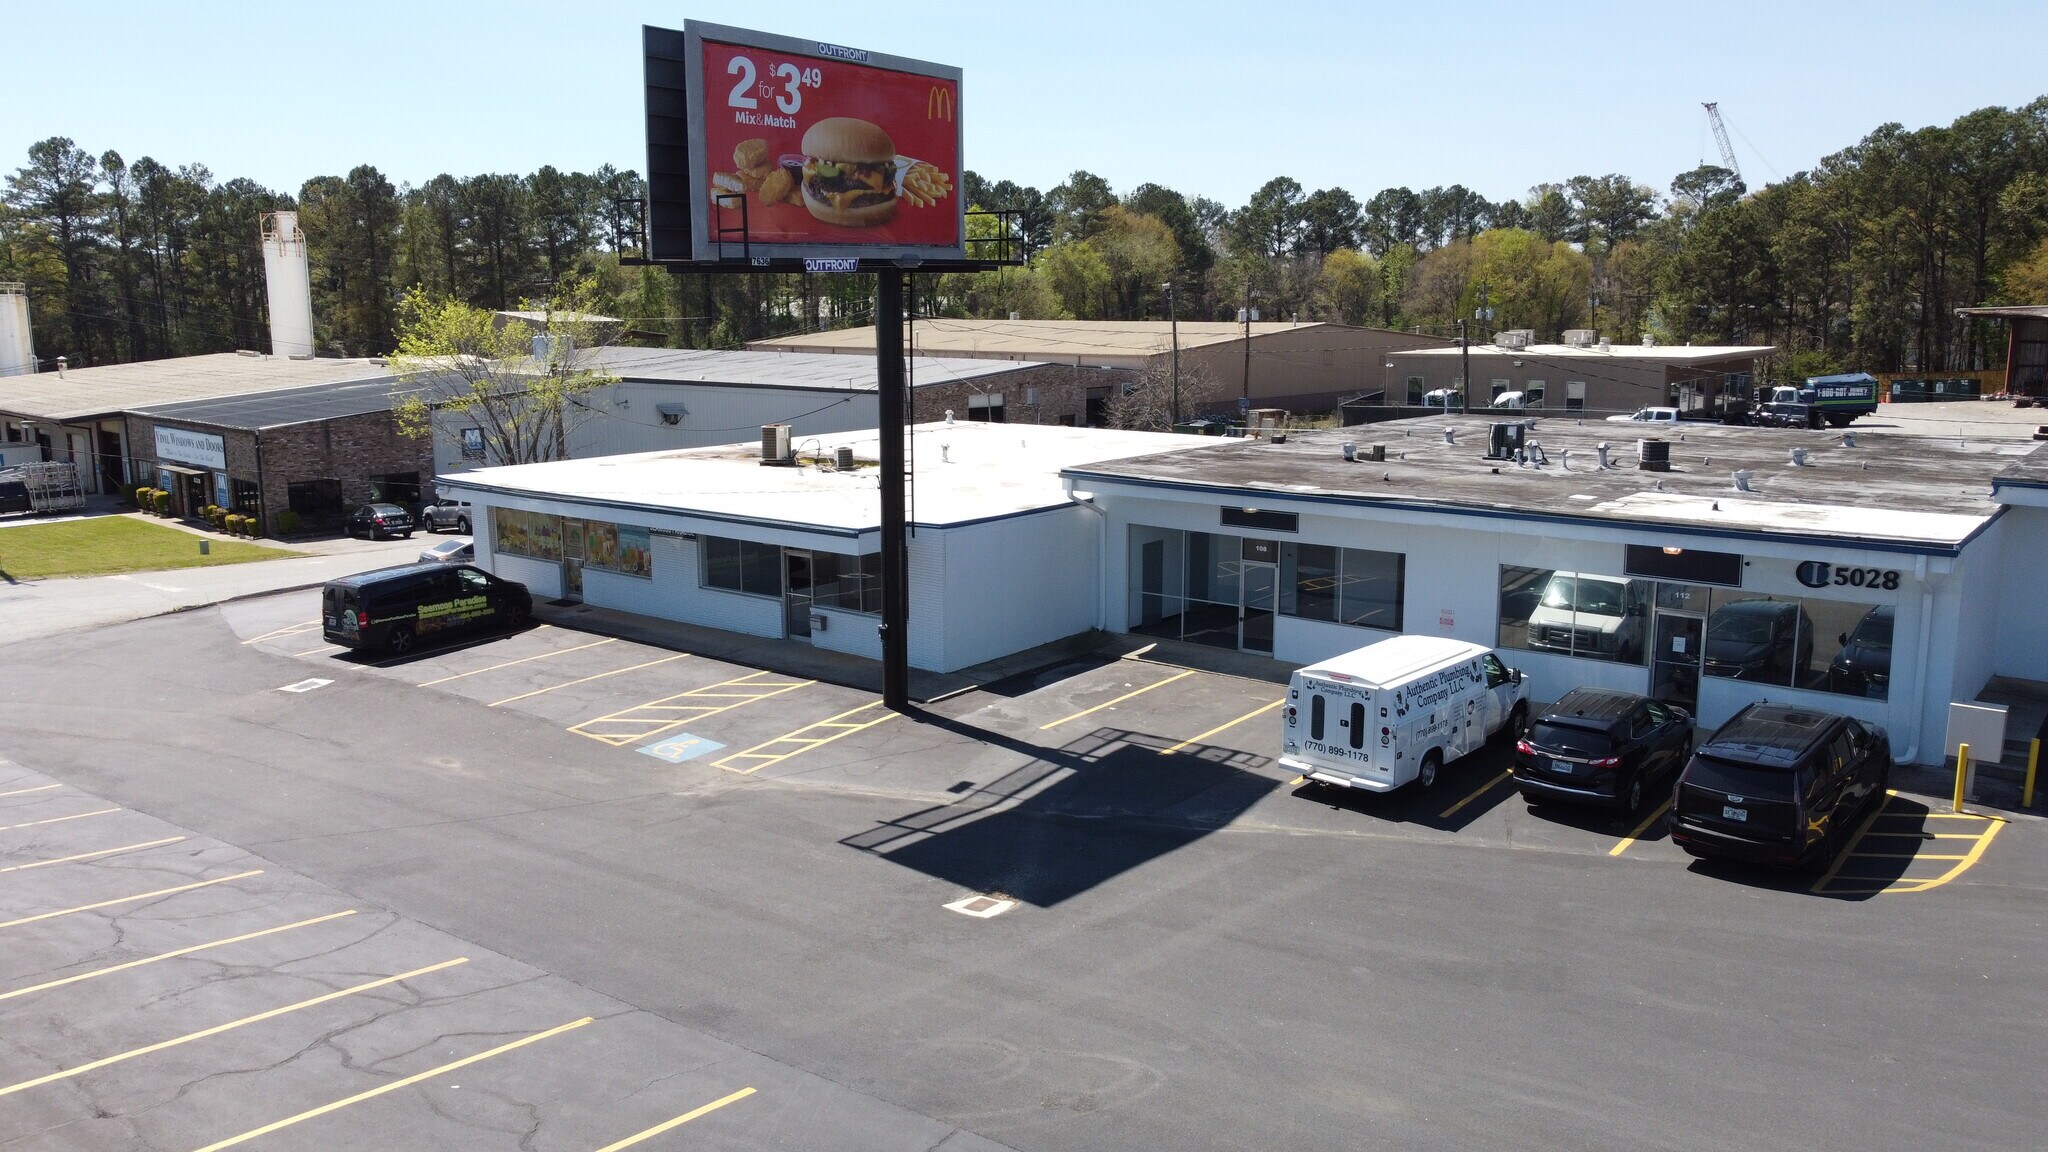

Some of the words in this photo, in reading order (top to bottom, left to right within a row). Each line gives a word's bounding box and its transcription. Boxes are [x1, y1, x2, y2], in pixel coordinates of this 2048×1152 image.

[818, 43, 868, 62] OUTFRONT
[727, 56, 758, 110] 2
[758, 80, 775, 99] for
[805, 259, 856, 271] OUTFRONT
[170, 432, 195, 449] WINDOWS
[205, 437, 224, 452] DOORS
[1833, 566, 1900, 590] 5028
[1675, 591, 1690, 600] 112
[1315, 680, 1338, 690] Authentic
[1338, 684, 1362, 695] Plumbing
[1406, 676, 1439, 699] Authentic
[1438, 664, 1471, 685] Plumbing
[1320, 686, 1343, 696] Company
[1344, 690, 1356, 699] LLC
[1416, 689, 1449, 708] Company
[1449, 678, 1466, 695] LLC
[1304, 740, 1327, 754] (770)
[1328, 745, 1369, 763] 899-1178
